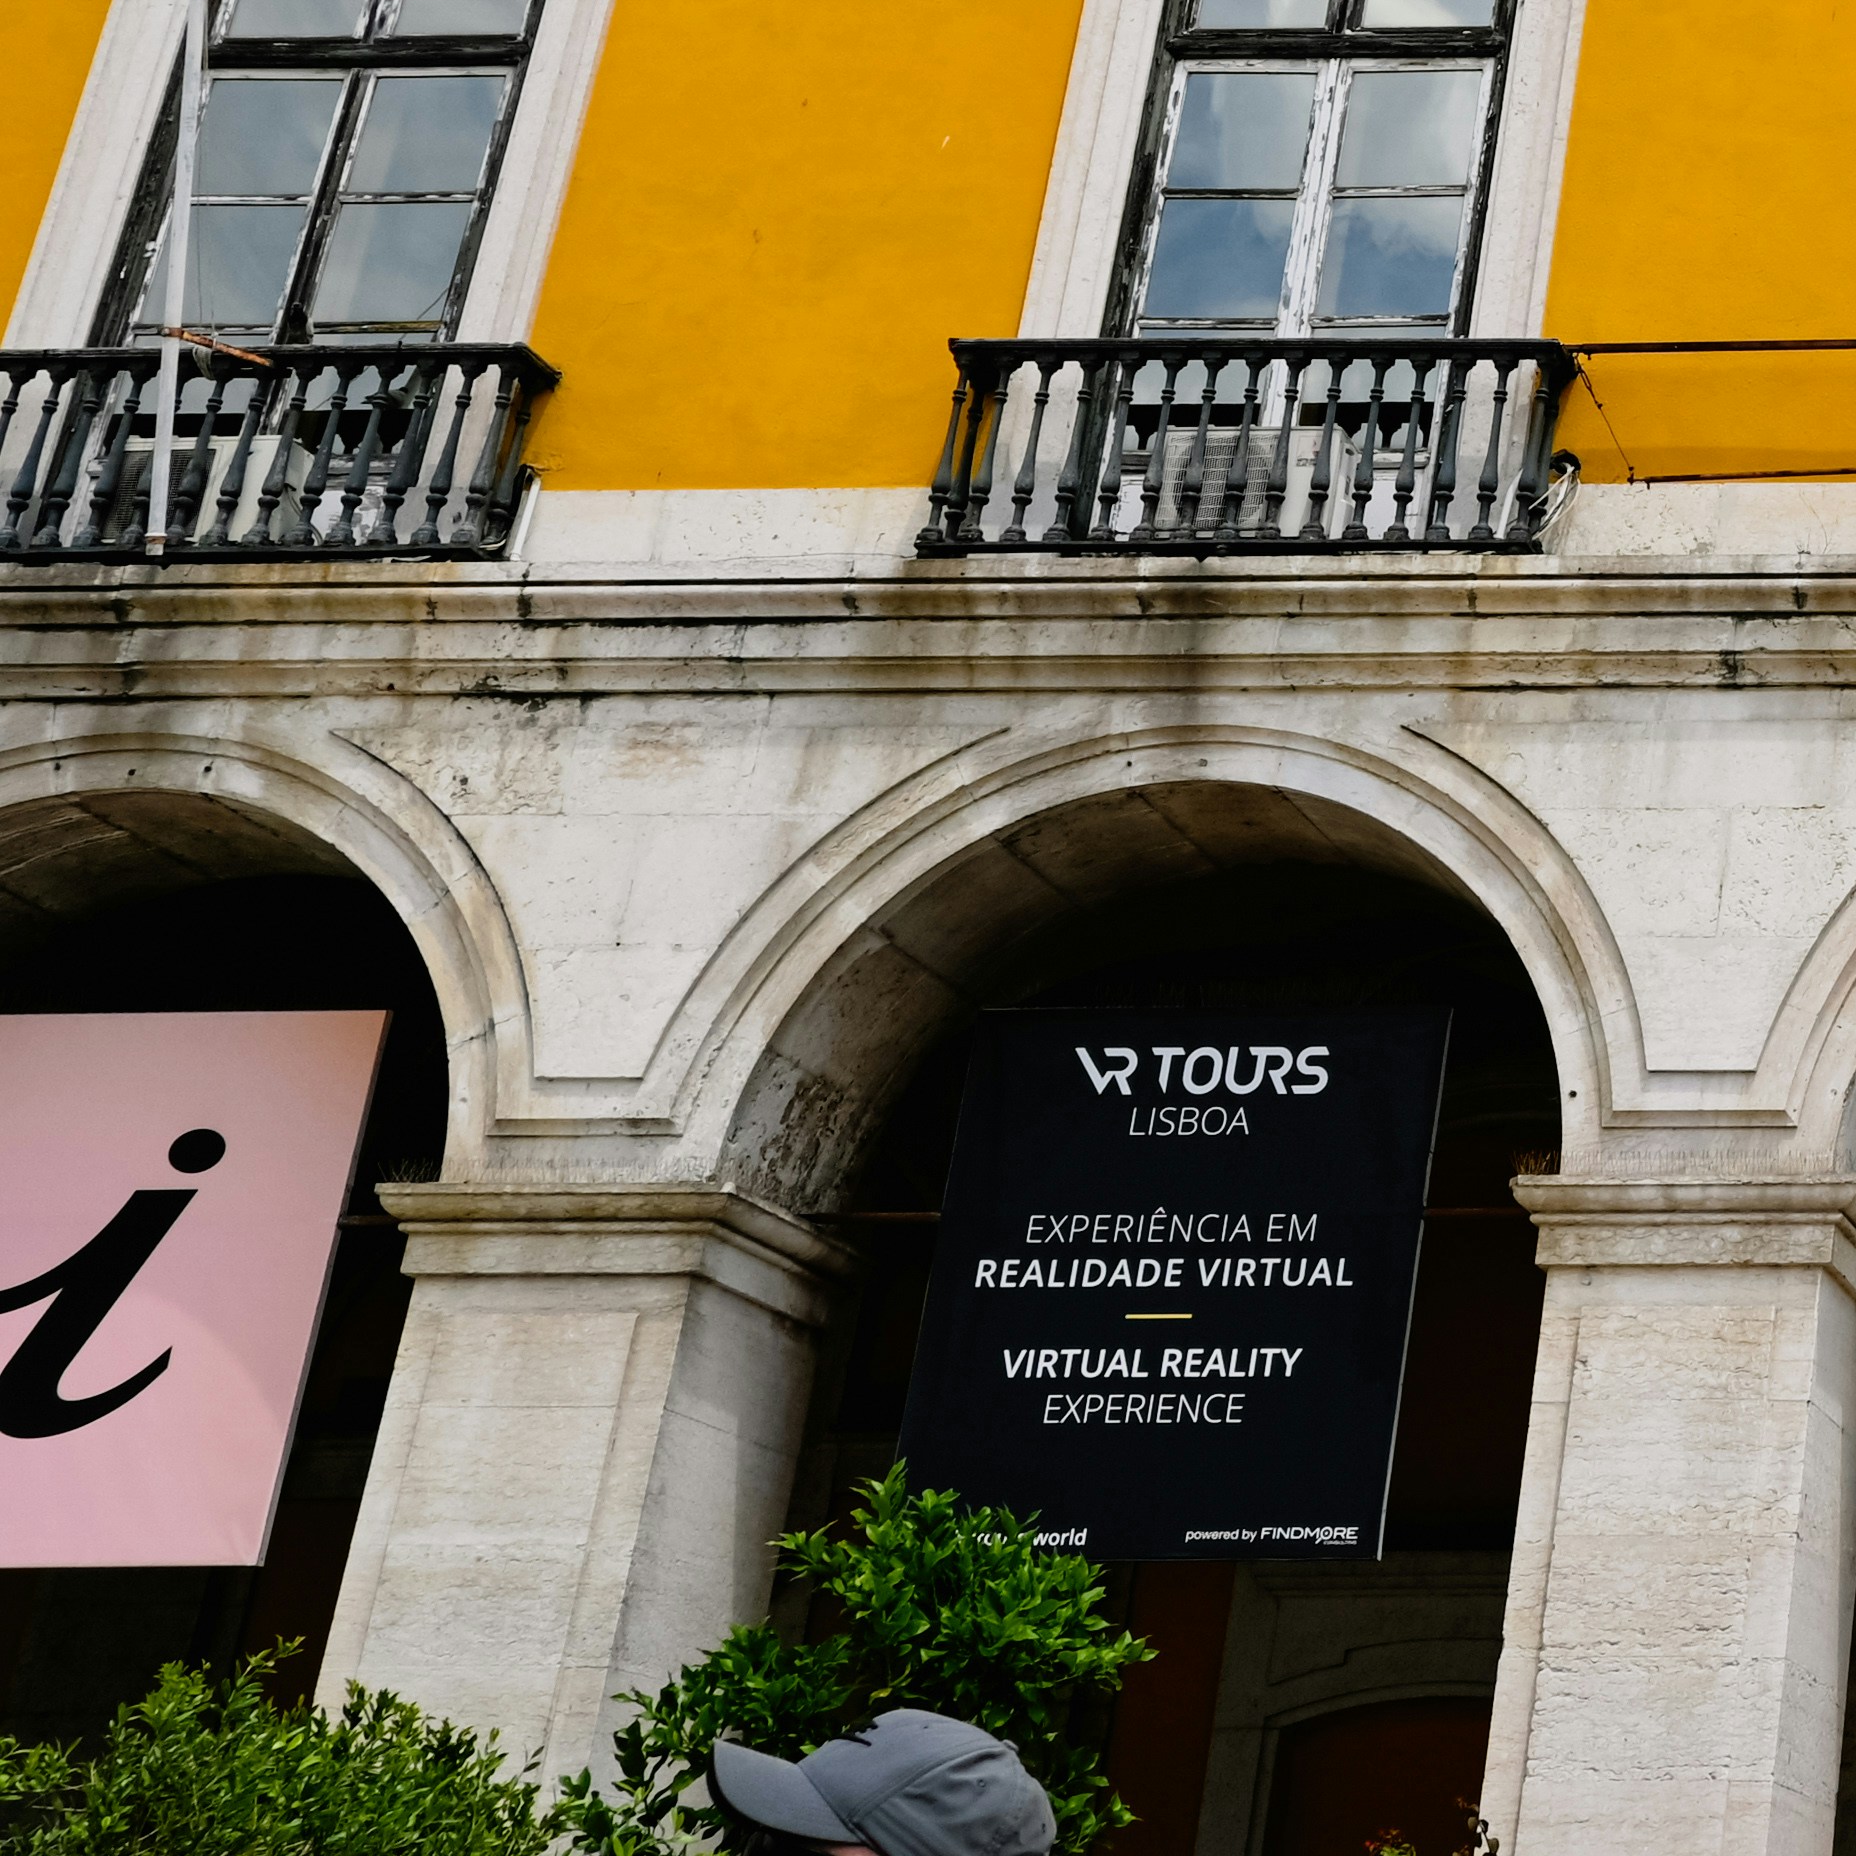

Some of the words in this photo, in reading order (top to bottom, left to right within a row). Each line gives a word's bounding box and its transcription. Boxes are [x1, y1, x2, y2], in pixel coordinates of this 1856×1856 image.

[1075, 1047, 1139, 1096] VR
[1151, 1046, 1330, 1095] TOURS
[1129, 1106, 1249, 1136] LISBOA
[1026, 1206, 1251, 1244] EXPERIÊNCIA
[1266, 1213, 1318, 1242] EM
[974, 1258, 1185, 1288] REALIDADE
[1198, 1257, 1354, 1287] VIRTUAL
[1003, 1348, 1149, 1379] VIRTUAL
[1160, 1347, 1303, 1378] REALITY
[1043, 1393, 1246, 1424] EXPERIENCE
[1184, 1528, 1240, 1543] powered
[1241, 1528, 1258, 1543] by
[1260, 1526, 1359, 1544] FINDMORE
